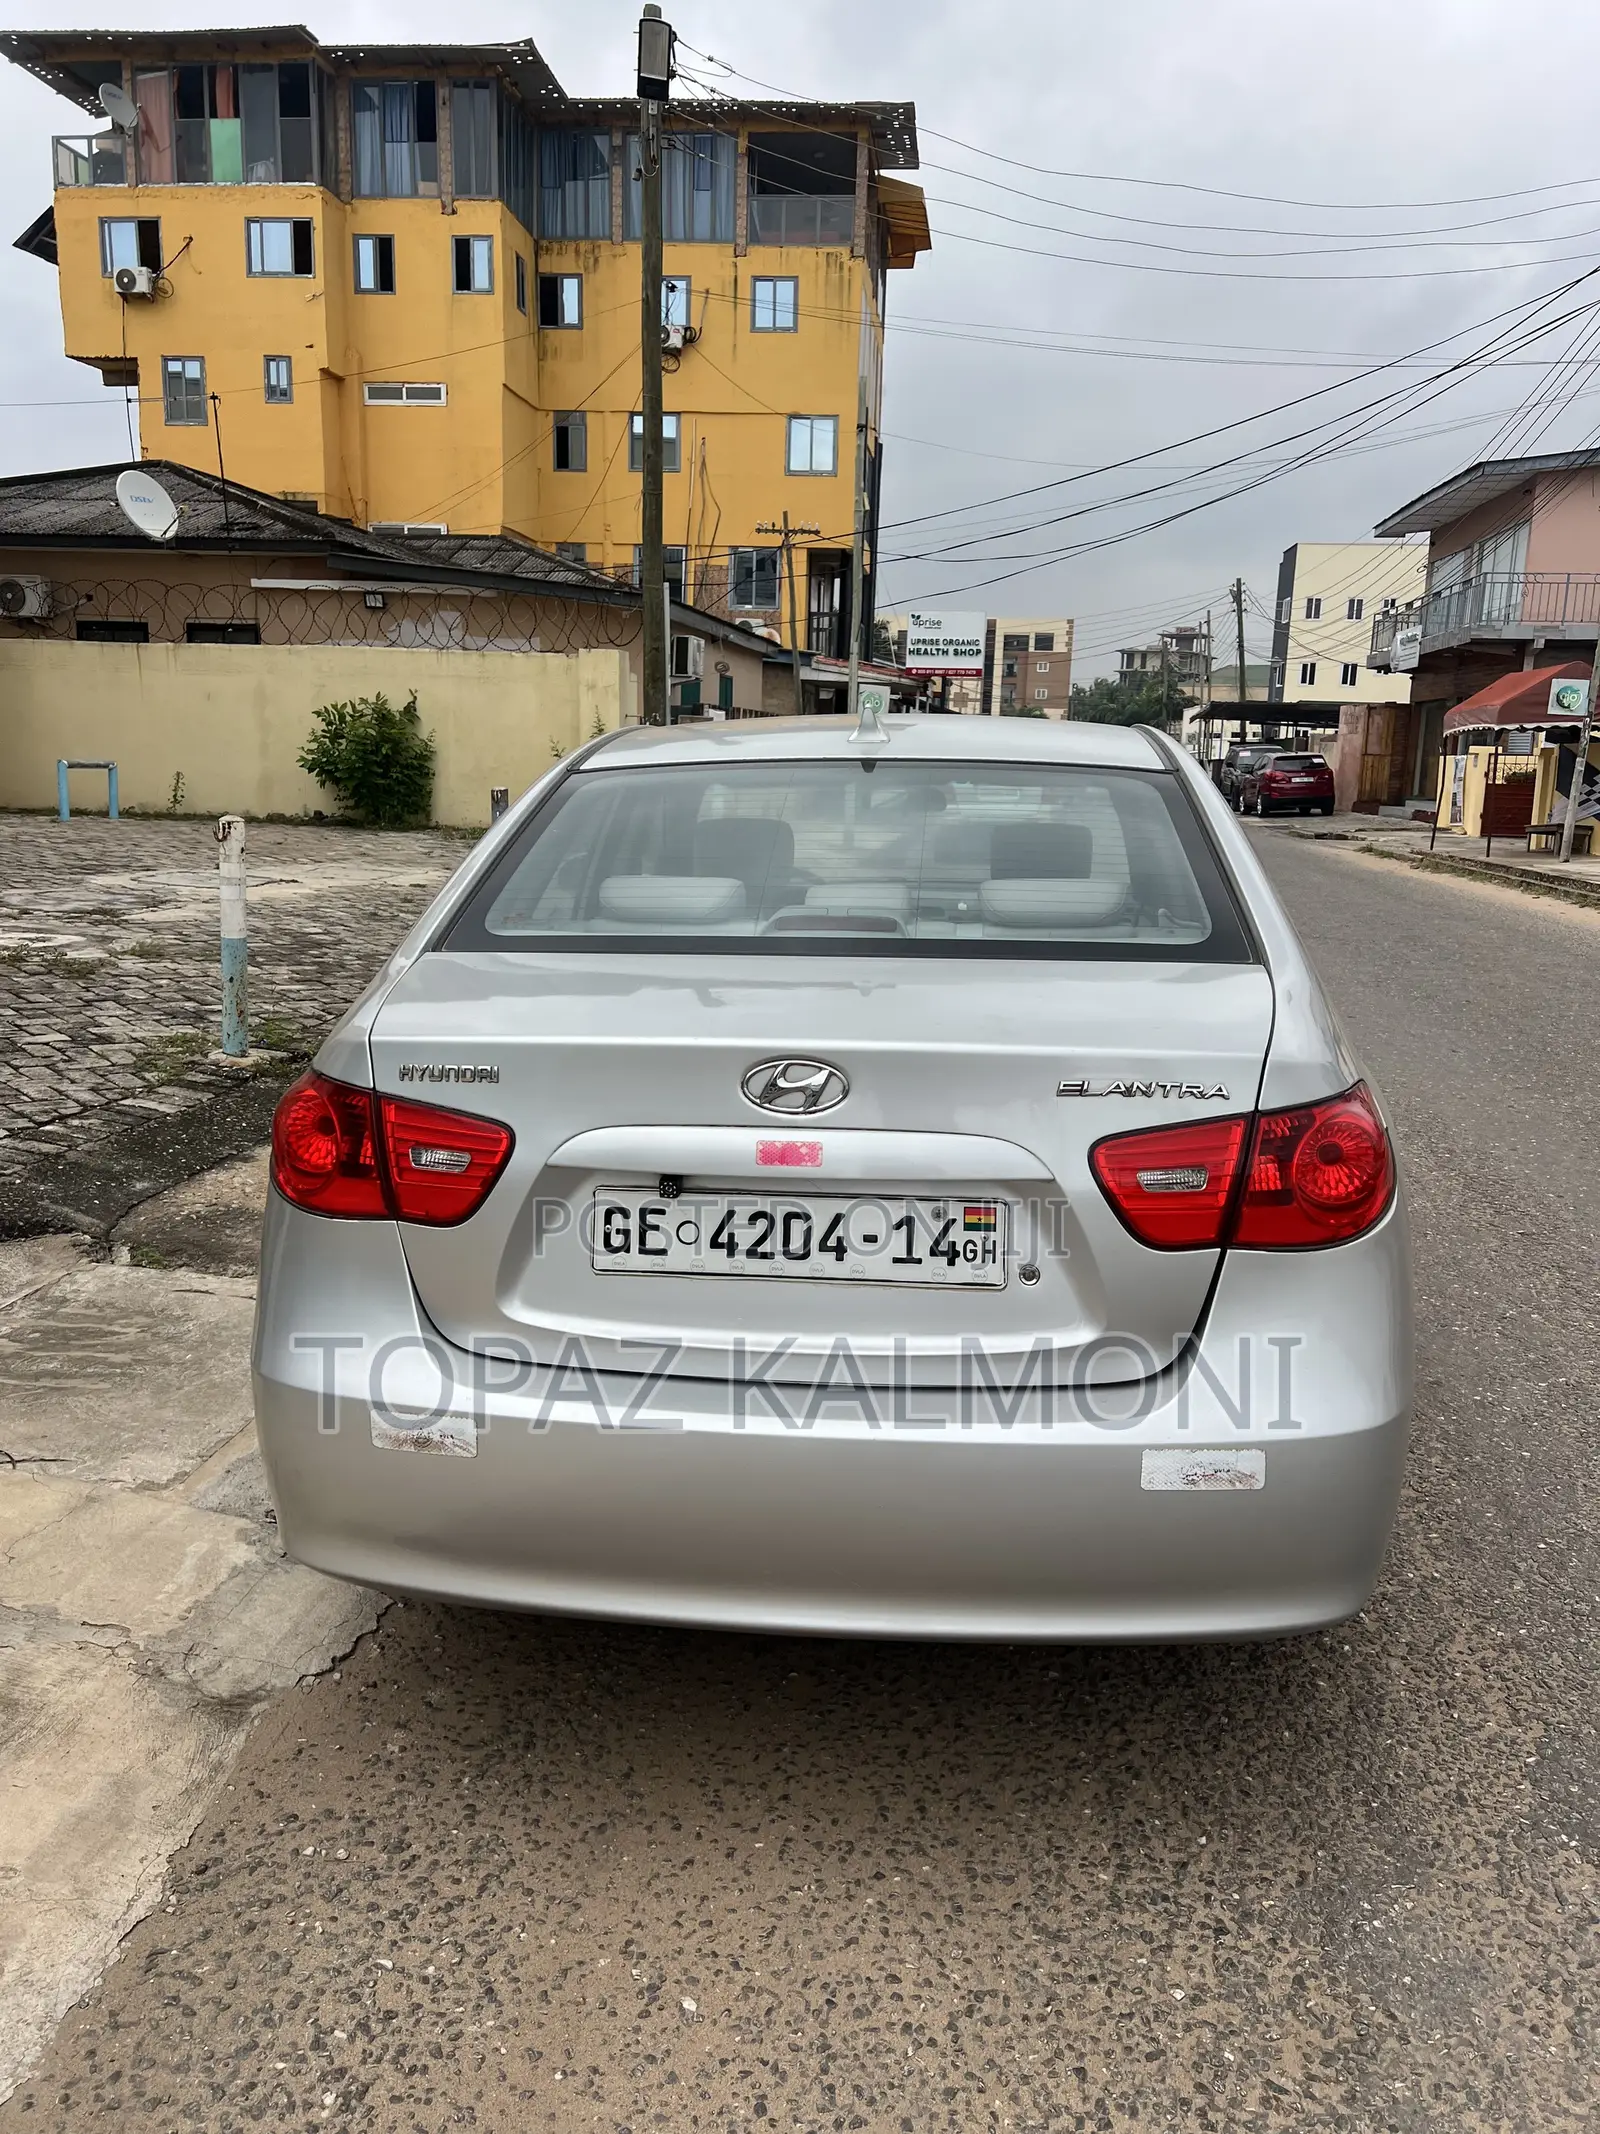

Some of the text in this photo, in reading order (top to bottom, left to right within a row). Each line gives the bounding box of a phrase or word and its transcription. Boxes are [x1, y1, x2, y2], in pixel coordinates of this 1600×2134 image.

[912, 618, 942, 628] uprise
[908, 647, 982, 657] HEALTH SHOP
[911, 638, 980, 647] UPRISE ORGANIC
[399, 1064, 499, 1083] HYUNDAI
[1056, 1080, 1231, 1100] ELANTRA
[603, 1206, 961, 1267] GE 4204-14
[963, 1239, 996, 1264] GH
